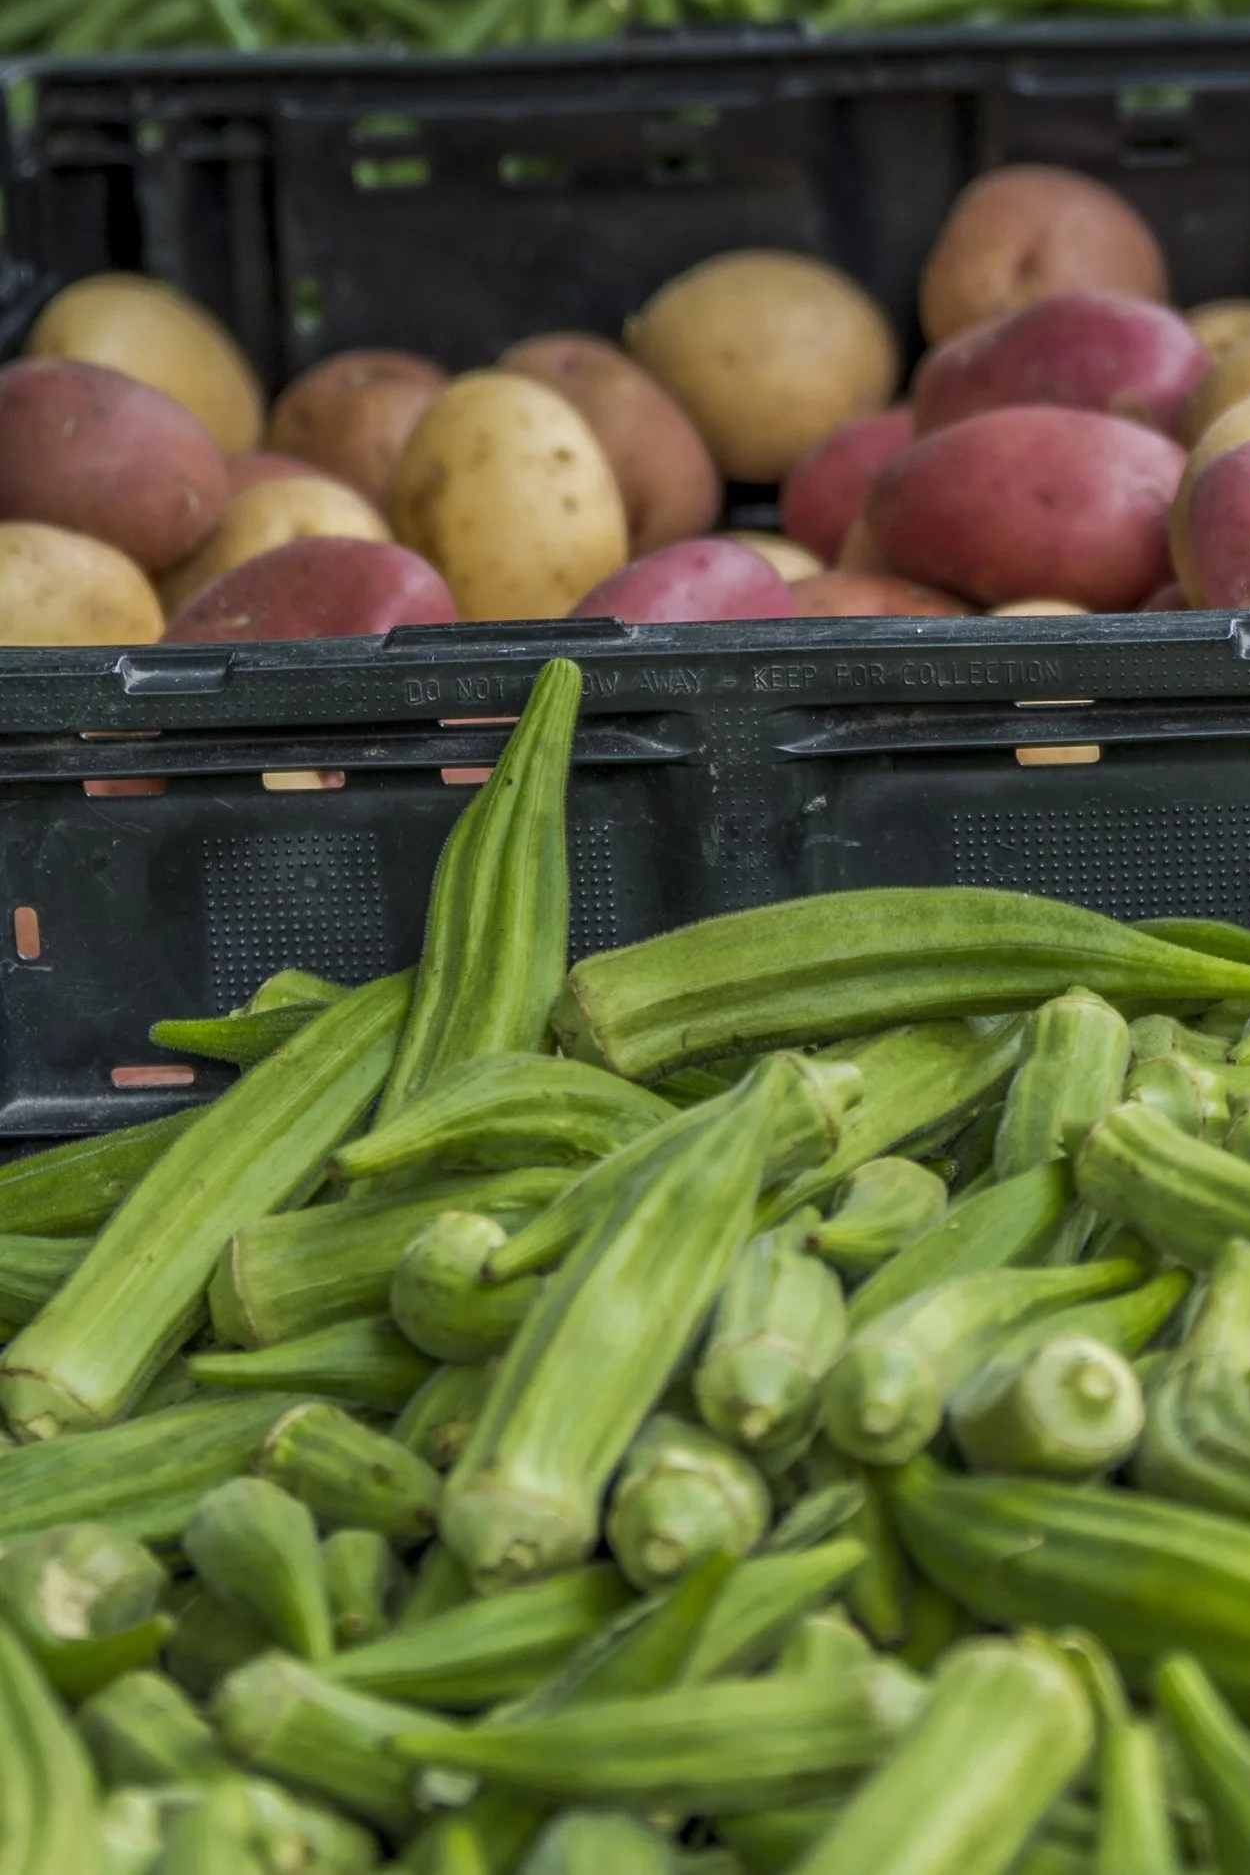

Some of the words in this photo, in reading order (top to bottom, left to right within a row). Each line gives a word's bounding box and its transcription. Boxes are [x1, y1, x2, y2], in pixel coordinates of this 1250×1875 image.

[406, 679, 441, 705] DO
[456, 676, 506, 701] NOT
[638, 668, 704, 695] AWAY
[751, 664, 817, 692] KEEP
[835, 663, 886, 687] FOR
[901, 660, 1062, 687] COLLECTION
